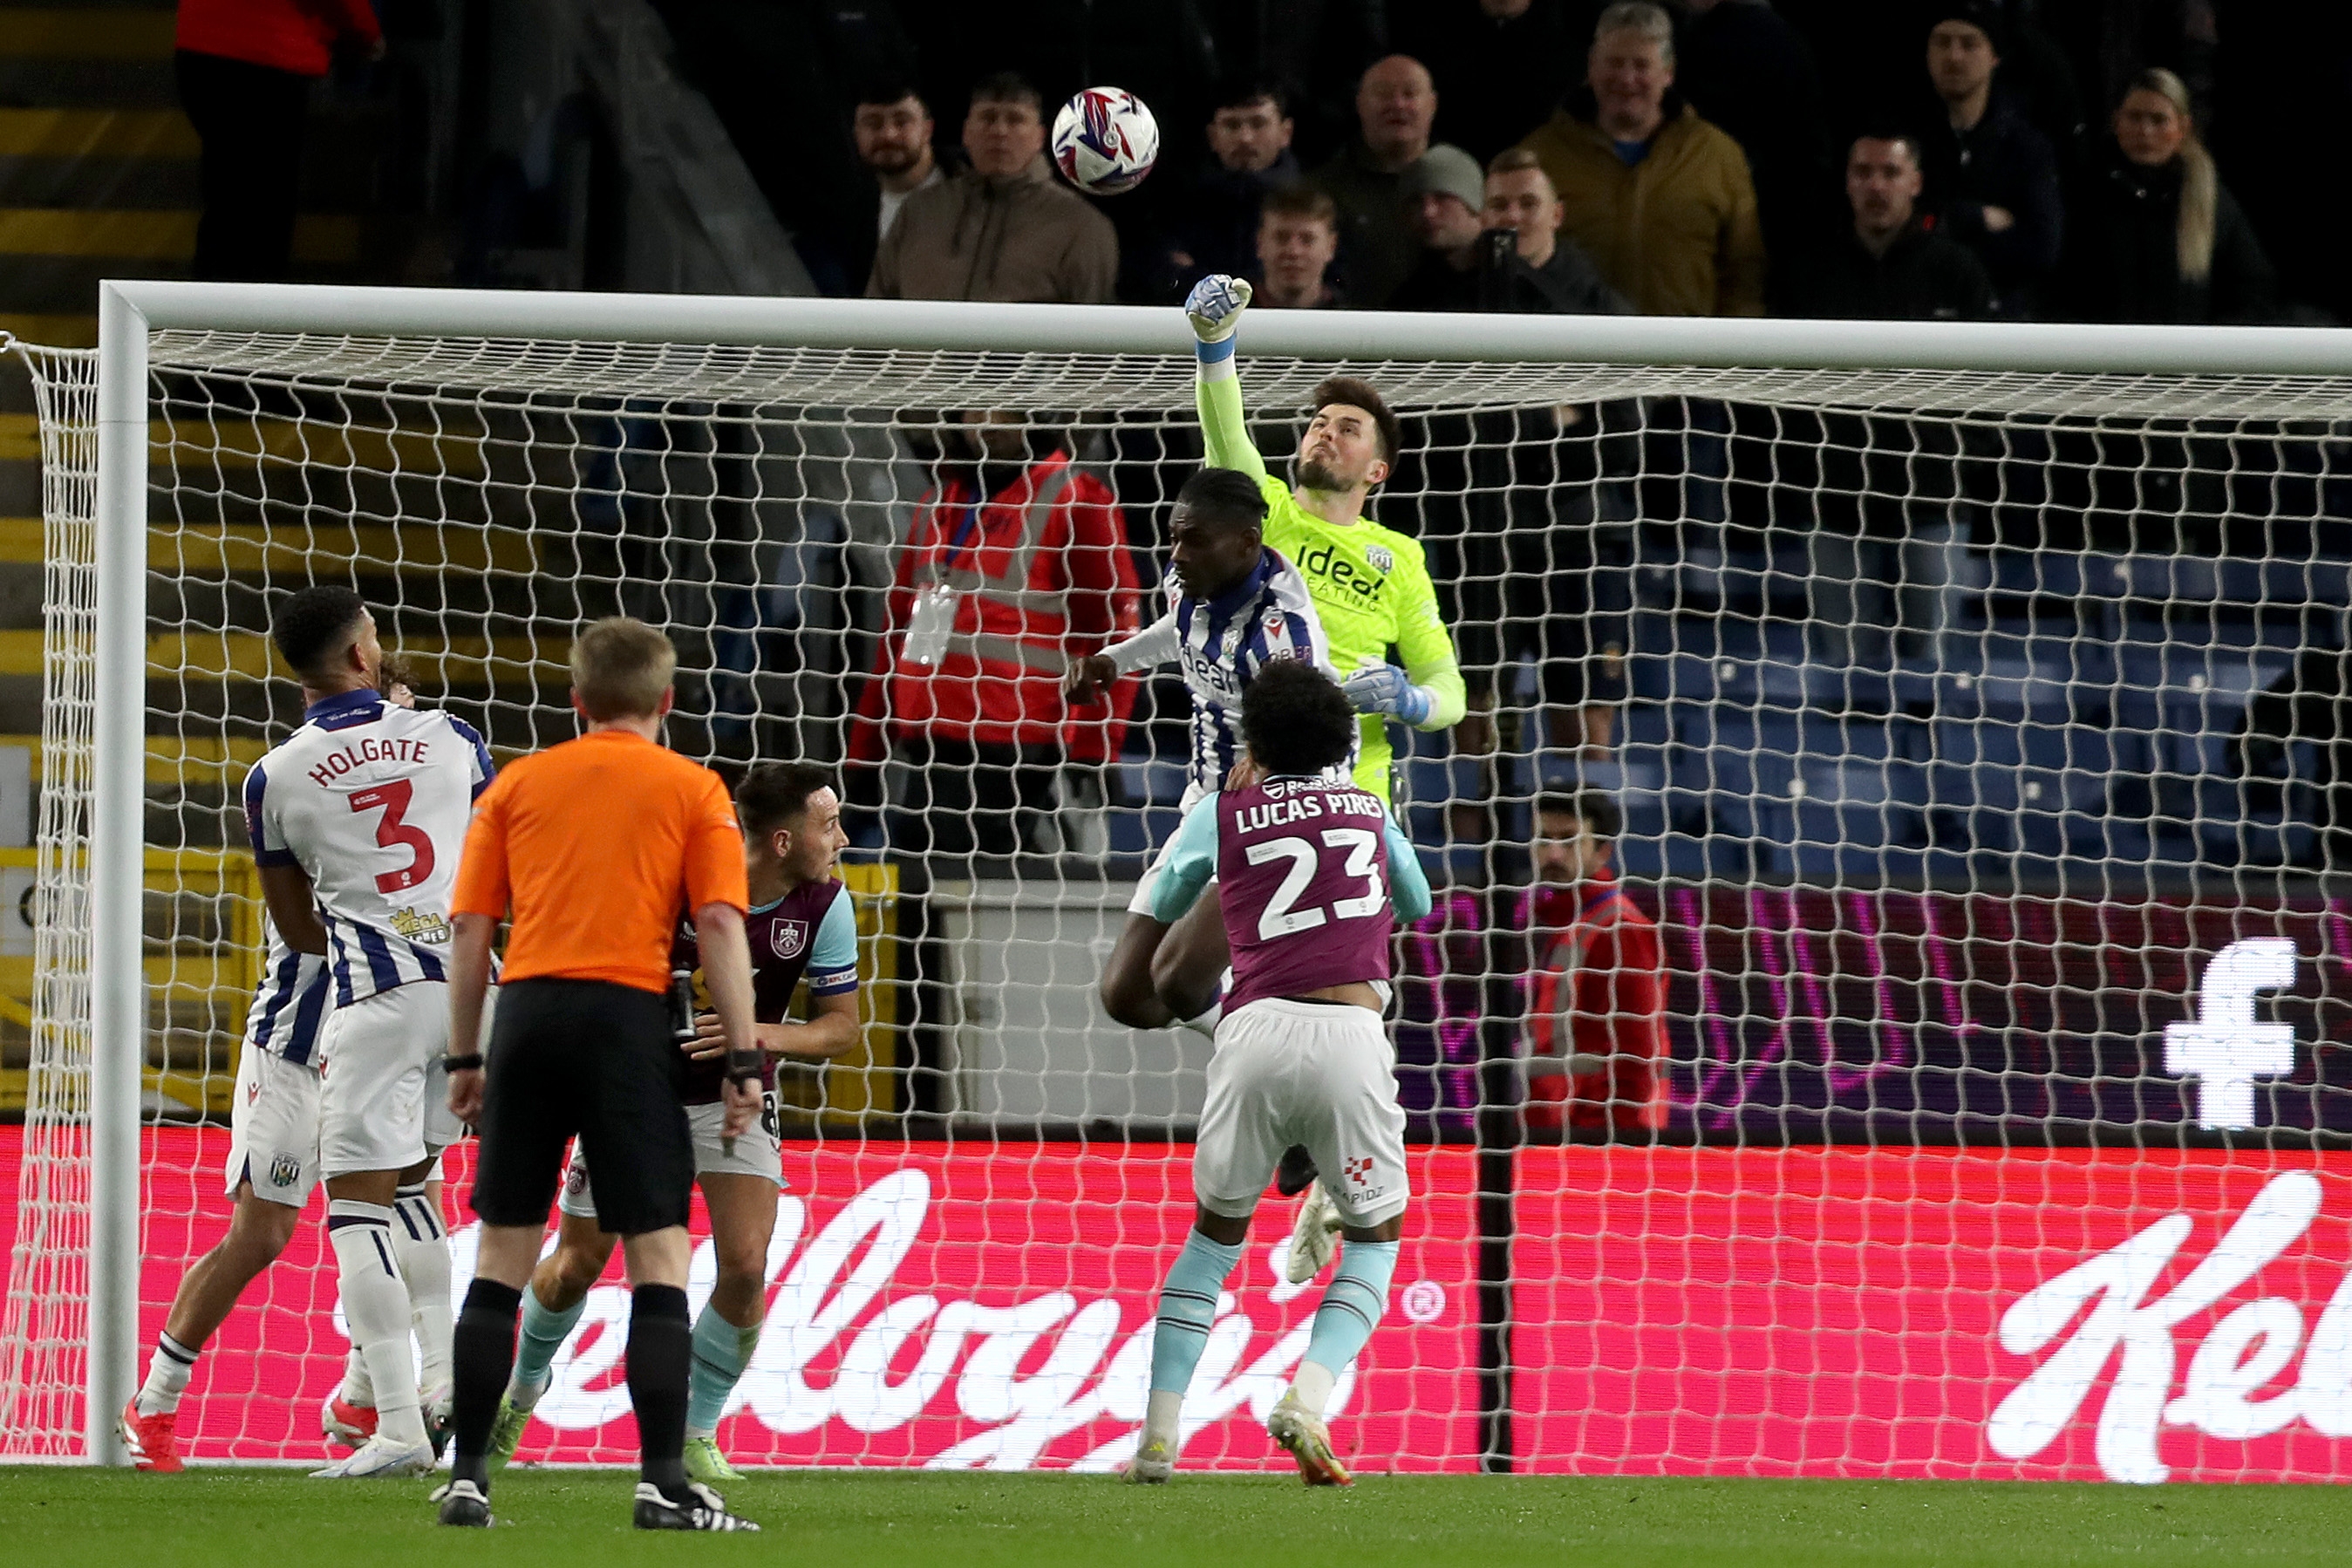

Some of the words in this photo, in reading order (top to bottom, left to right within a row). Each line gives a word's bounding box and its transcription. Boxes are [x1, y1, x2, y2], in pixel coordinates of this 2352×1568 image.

[1307, 576, 1380, 612] EATING
[1181, 644, 1234, 695] deal
[307, 738, 429, 787] HOLGATE
[348, 778, 435, 895] 3
[1235, 795, 1324, 835] LUCAS
[1324, 793, 1384, 819] PIRES
[1244, 828, 1387, 942] 23
[398, 913, 442, 935] MEGA
[327, 1169, 1392, 1472] ellogg's
